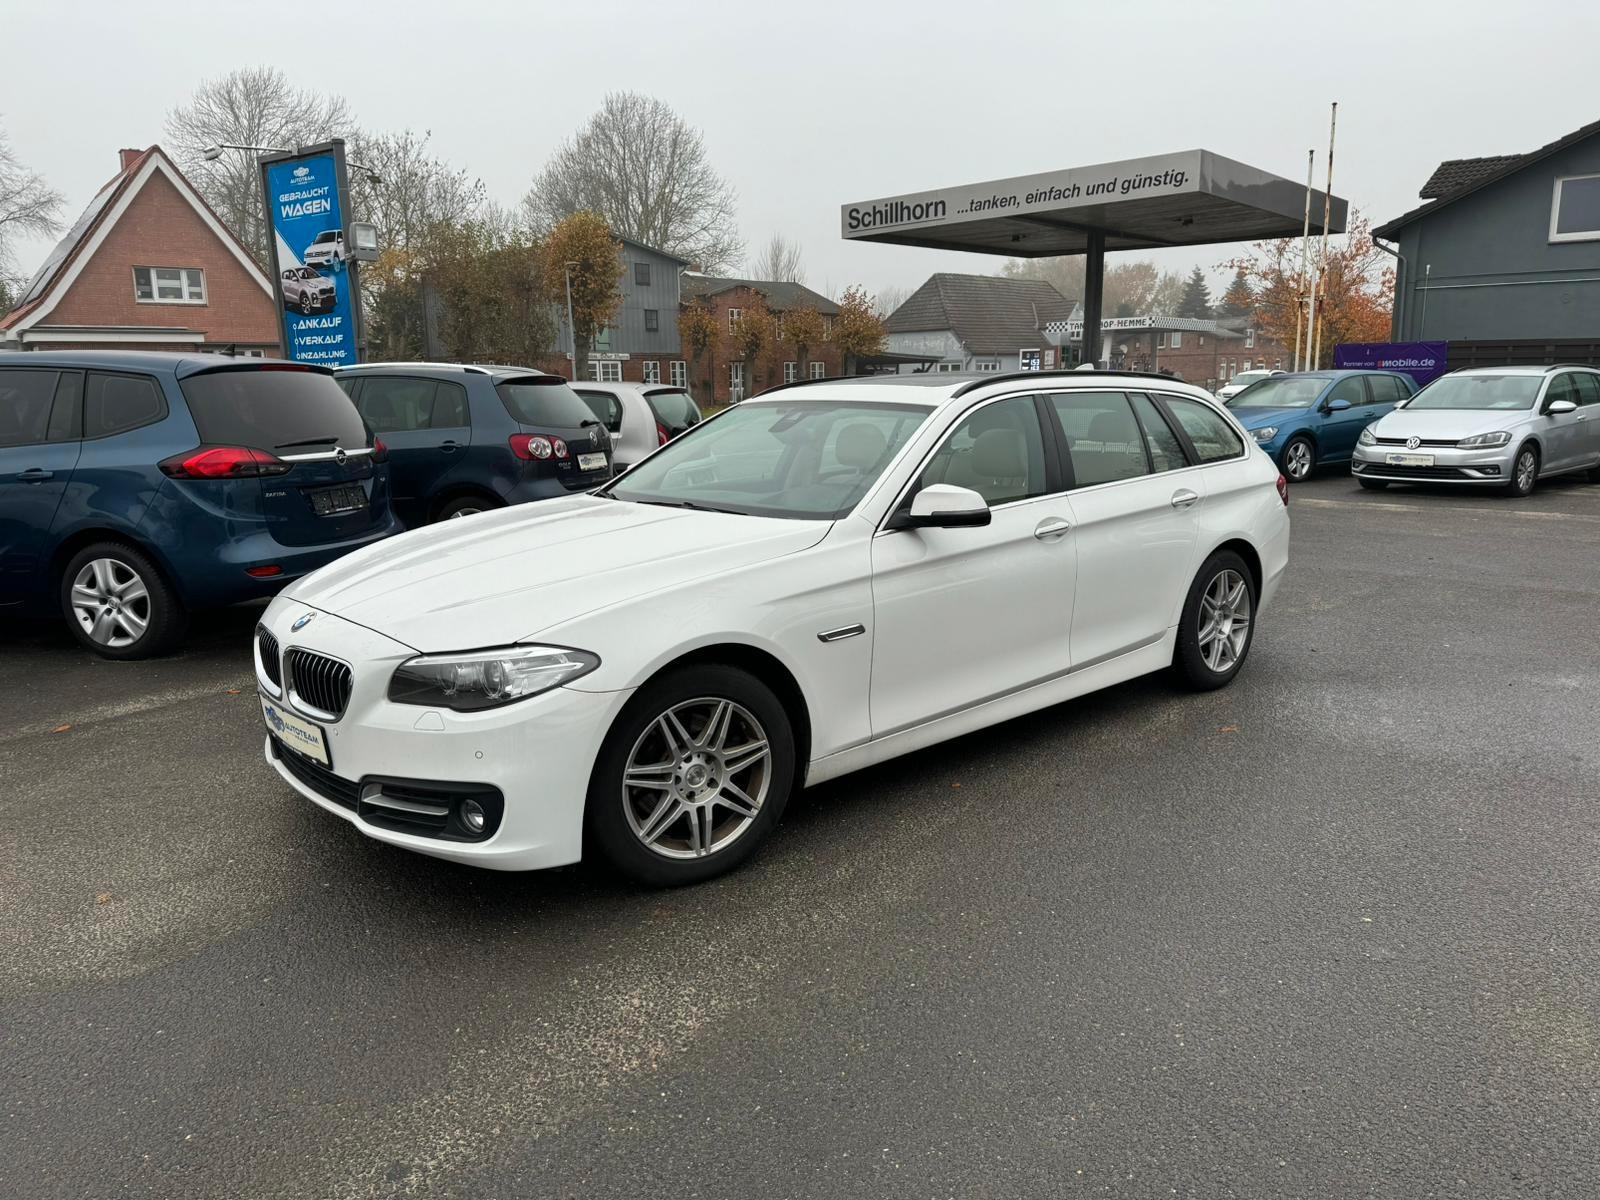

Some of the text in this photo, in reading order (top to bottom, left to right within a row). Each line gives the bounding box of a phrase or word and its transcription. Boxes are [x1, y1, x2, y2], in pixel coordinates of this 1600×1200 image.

[290, 176, 315, 184] AUTOTEAM
[279, 186, 329, 202] GEBRAUCHT
[848, 199, 946, 229] Schillhorn
[1025, 184, 1081, 204] einfach
[1085, 177, 1118, 196] und
[1121, 169, 1189, 194] günstig.
[281, 198, 331, 218] WAGEN
[297, 316, 342, 330] ANKAUF
[299, 335, 343, 345] VERKAUF
[1381, 359, 1435, 367] mobile.de
[285, 723, 319, 743] AUTOTEAM
